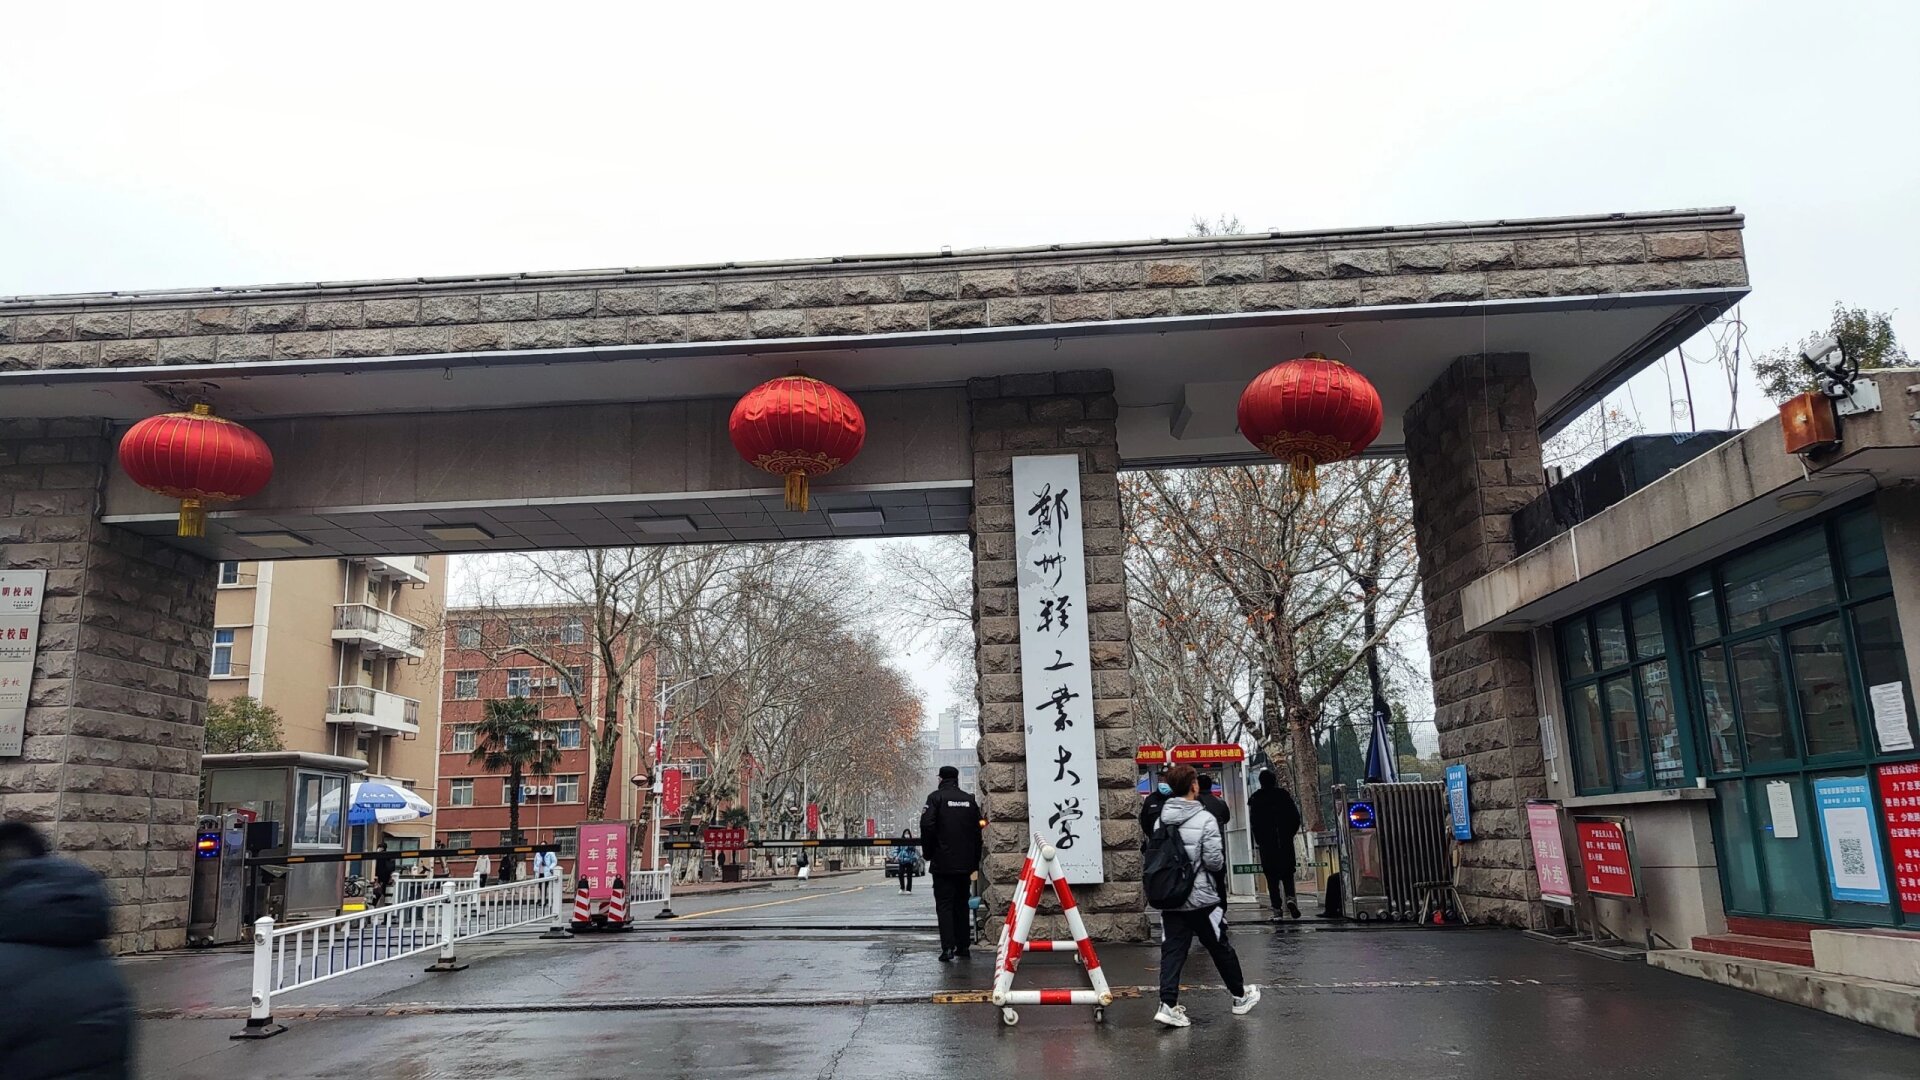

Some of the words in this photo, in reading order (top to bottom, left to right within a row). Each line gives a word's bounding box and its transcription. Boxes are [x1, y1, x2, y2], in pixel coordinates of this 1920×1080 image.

[1537, 840, 1560, 858] 禁止
[587, 838, 600, 889] 一车一档
[1897, 863, 1920, 872] 小区1
[1541, 863, 1564, 884] 外卖
